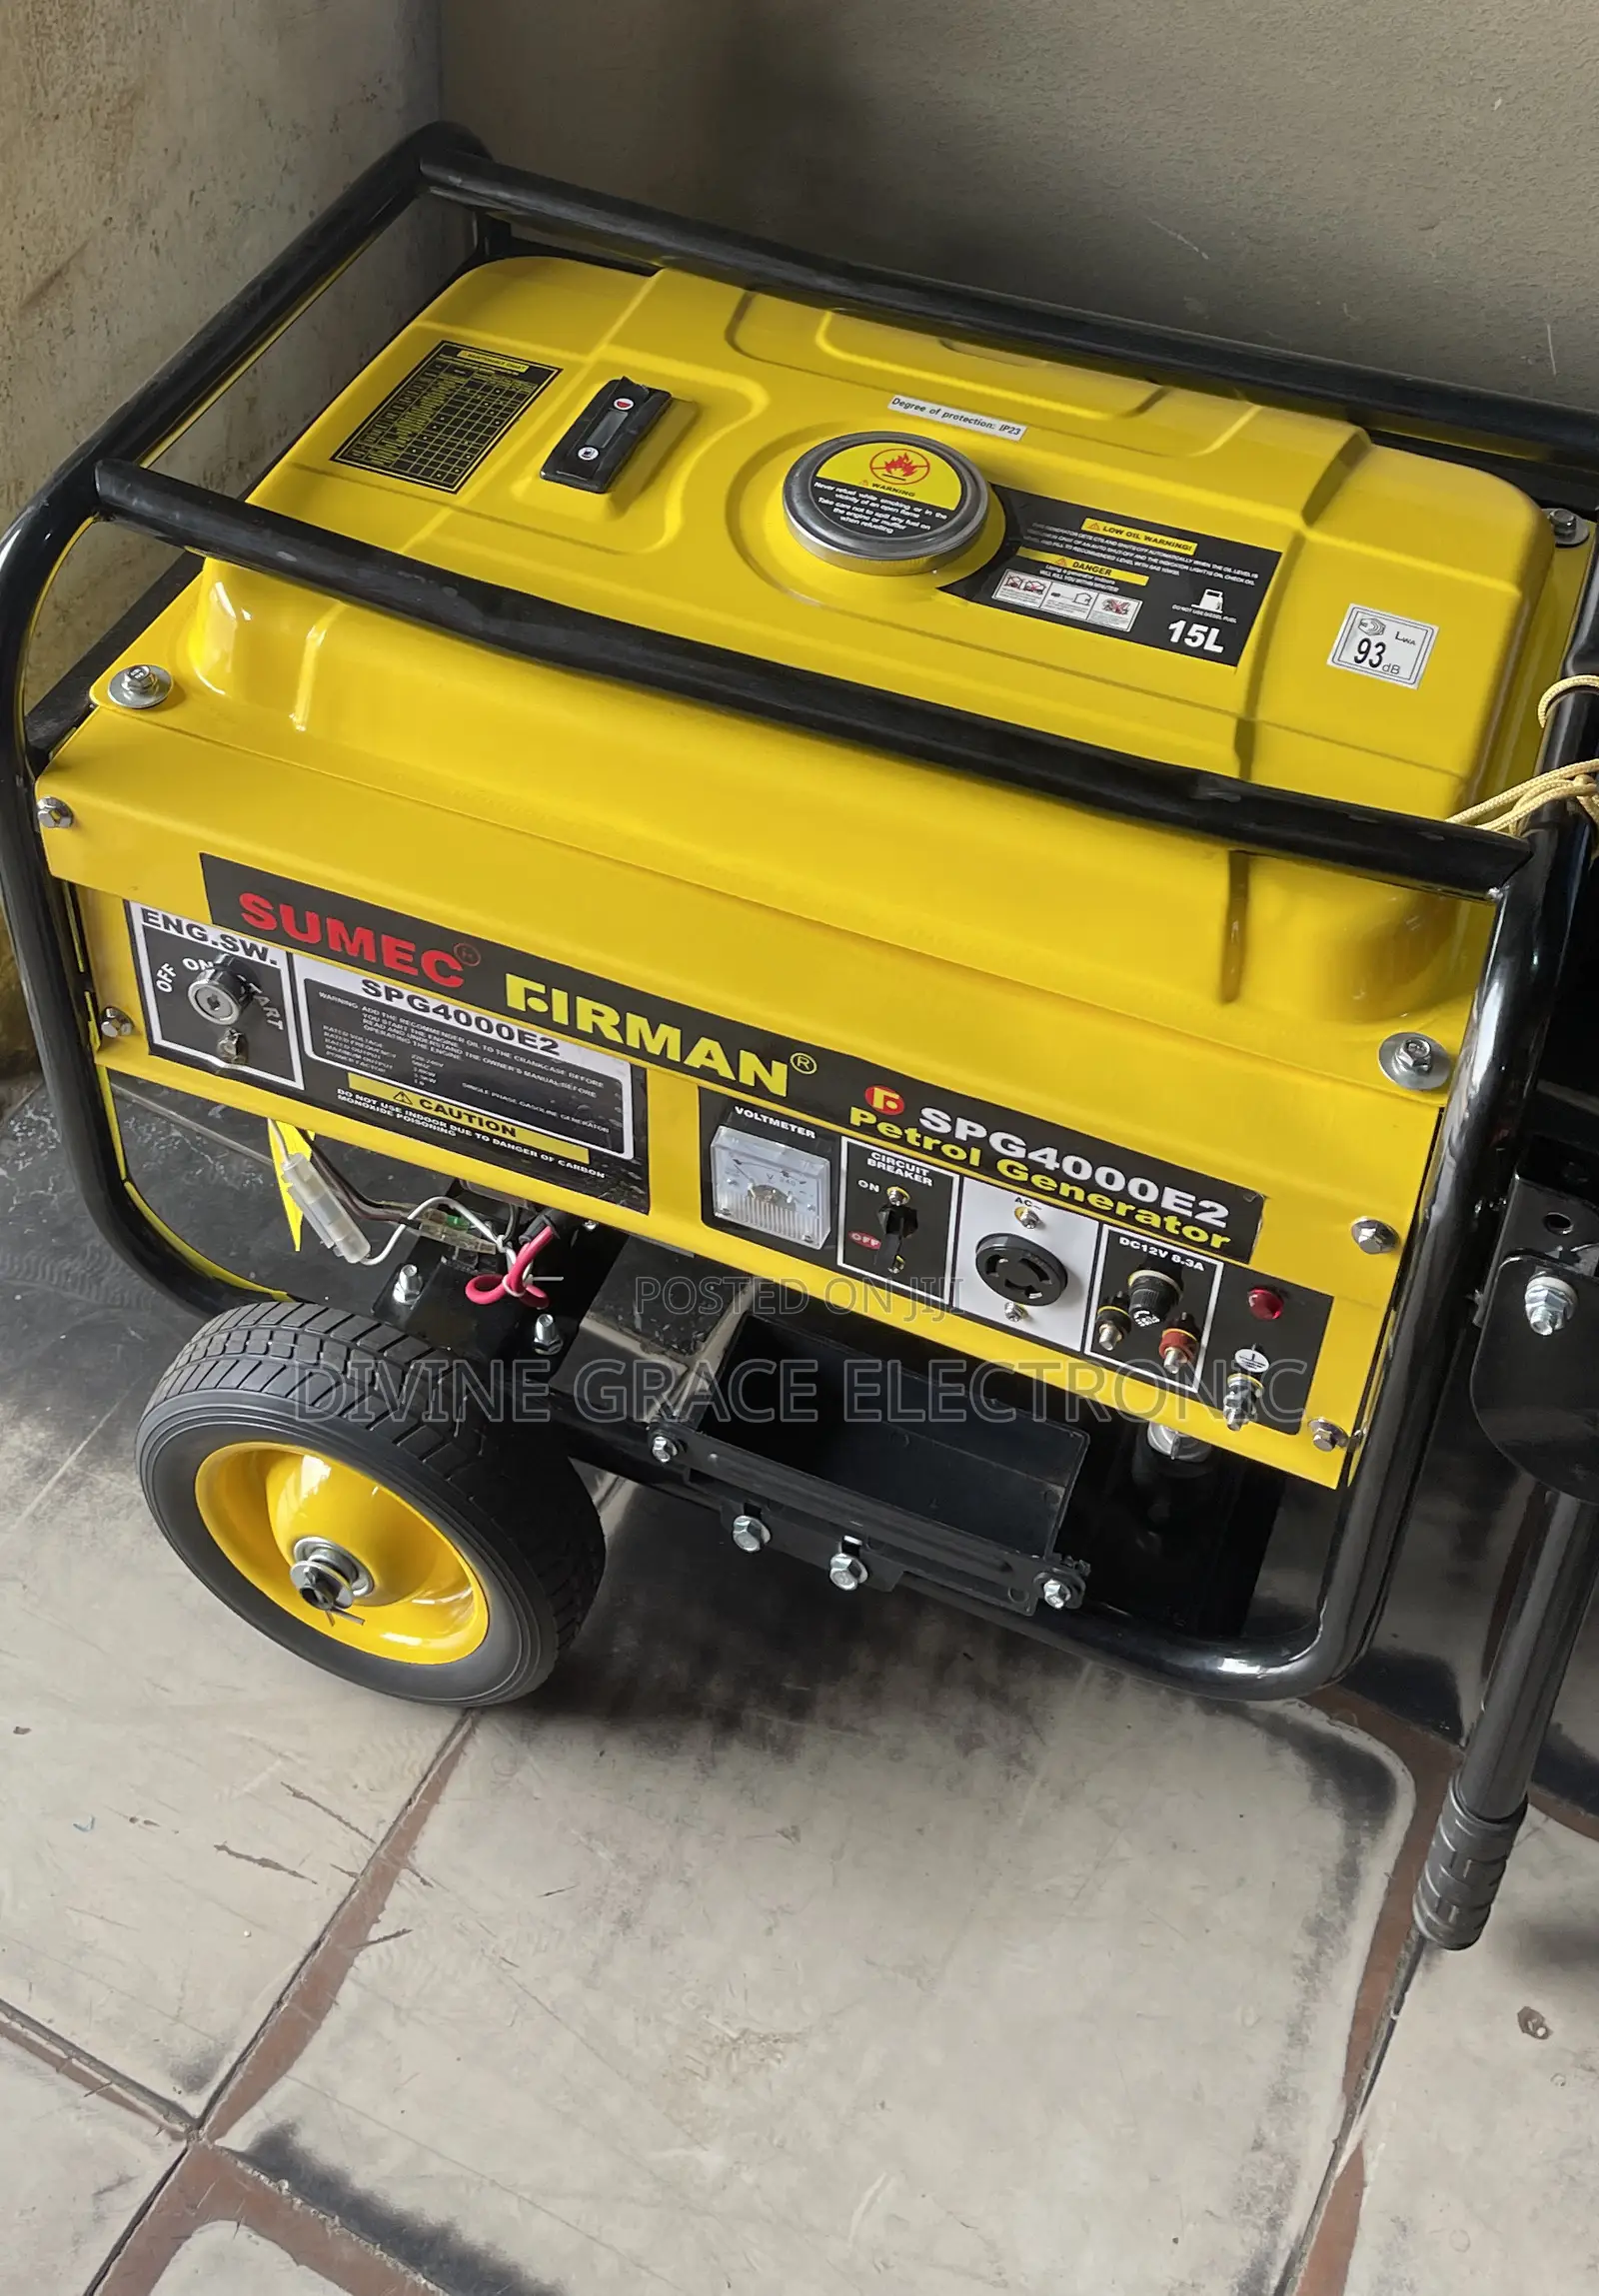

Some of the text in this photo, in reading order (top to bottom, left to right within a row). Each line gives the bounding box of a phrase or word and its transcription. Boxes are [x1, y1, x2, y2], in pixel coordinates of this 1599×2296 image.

[891, 398, 926, 413] Degree
[941, 410, 995, 430] protection:
[998, 424, 1021, 436] IP23
[814, 482, 835, 491] Never
[835, 487, 856, 496] refuel
[879, 499, 911, 511] smoking
[835, 493, 859, 504] vicinity
[879, 505, 899, 514] open
[871, 483, 916, 498] WARNING
[817, 497, 834, 506] Take
[834, 501, 851, 510] care
[904, 519, 920, 528] fuel
[839, 516, 860, 525] when
[845, 511, 871, 521] engine
[1102, 526, 1193, 552] LOW OIL WARNING!
[1072, 561, 1112, 576] DANGER
[1168, 619, 1224, 653] 15L
[1353, 637, 1401, 675] 93 dB
[141, 906, 278, 966] ENG.SW.
[239, 892, 465, 988] SUMEC
[156, 963, 177, 993] OFF
[182, 957, 215, 971] ON
[237, 974, 284, 1031] TART
[361, 979, 561, 1056] SPG4000E2
[363, 1013, 381, 1023] YOU
[382, 1019, 408, 1032] START
[411, 1029, 428, 1039] THE
[363, 1025, 411, 1046] OPERATING
[413, 1041, 429, 1051] THE
[505, 972, 788, 1097] FIRMAN
[362, 1018, 387, 1030] READ
[387, 1026, 405, 1037] AND
[407, 1031, 463, 1055] UNDERSTAND
[465, 1052, 482, 1062] THE
[483, 1057, 523, 1074] OWNER'S
[362, 1006, 380, 1016] ADD
[381, 1012, 398, 1021] THE
[466, 1038, 480, 1049] OIL
[483, 1043, 495, 1053] TO
[496, 1049, 512, 1059] THE
[514, 1055, 567, 1076] CRANKCASE
[569, 1072, 605, 1089] BEFORE
[337, 1094, 457, 1137] MONOXIDE POISONING
[420, 1099, 517, 1138] CAUTION
[735, 1106, 816, 1139] VOLTMETER
[337, 1088, 606, 1179] DO NOT USE INDOOR DUE TO DANGER OF CARBON
[849, 1106, 1233, 1250] Petrol Generator
[866, 1158, 933, 1187] BREAKER
[870, 1152, 929, 1176] CIRCUIT
[919, 1106, 1230, 1229] SPG4000E2
[857, 1179, 879, 1193] ON
[851, 1233, 879, 1247] OFF
[1119, 1237, 1205, 1272] DC12V 8.3A
